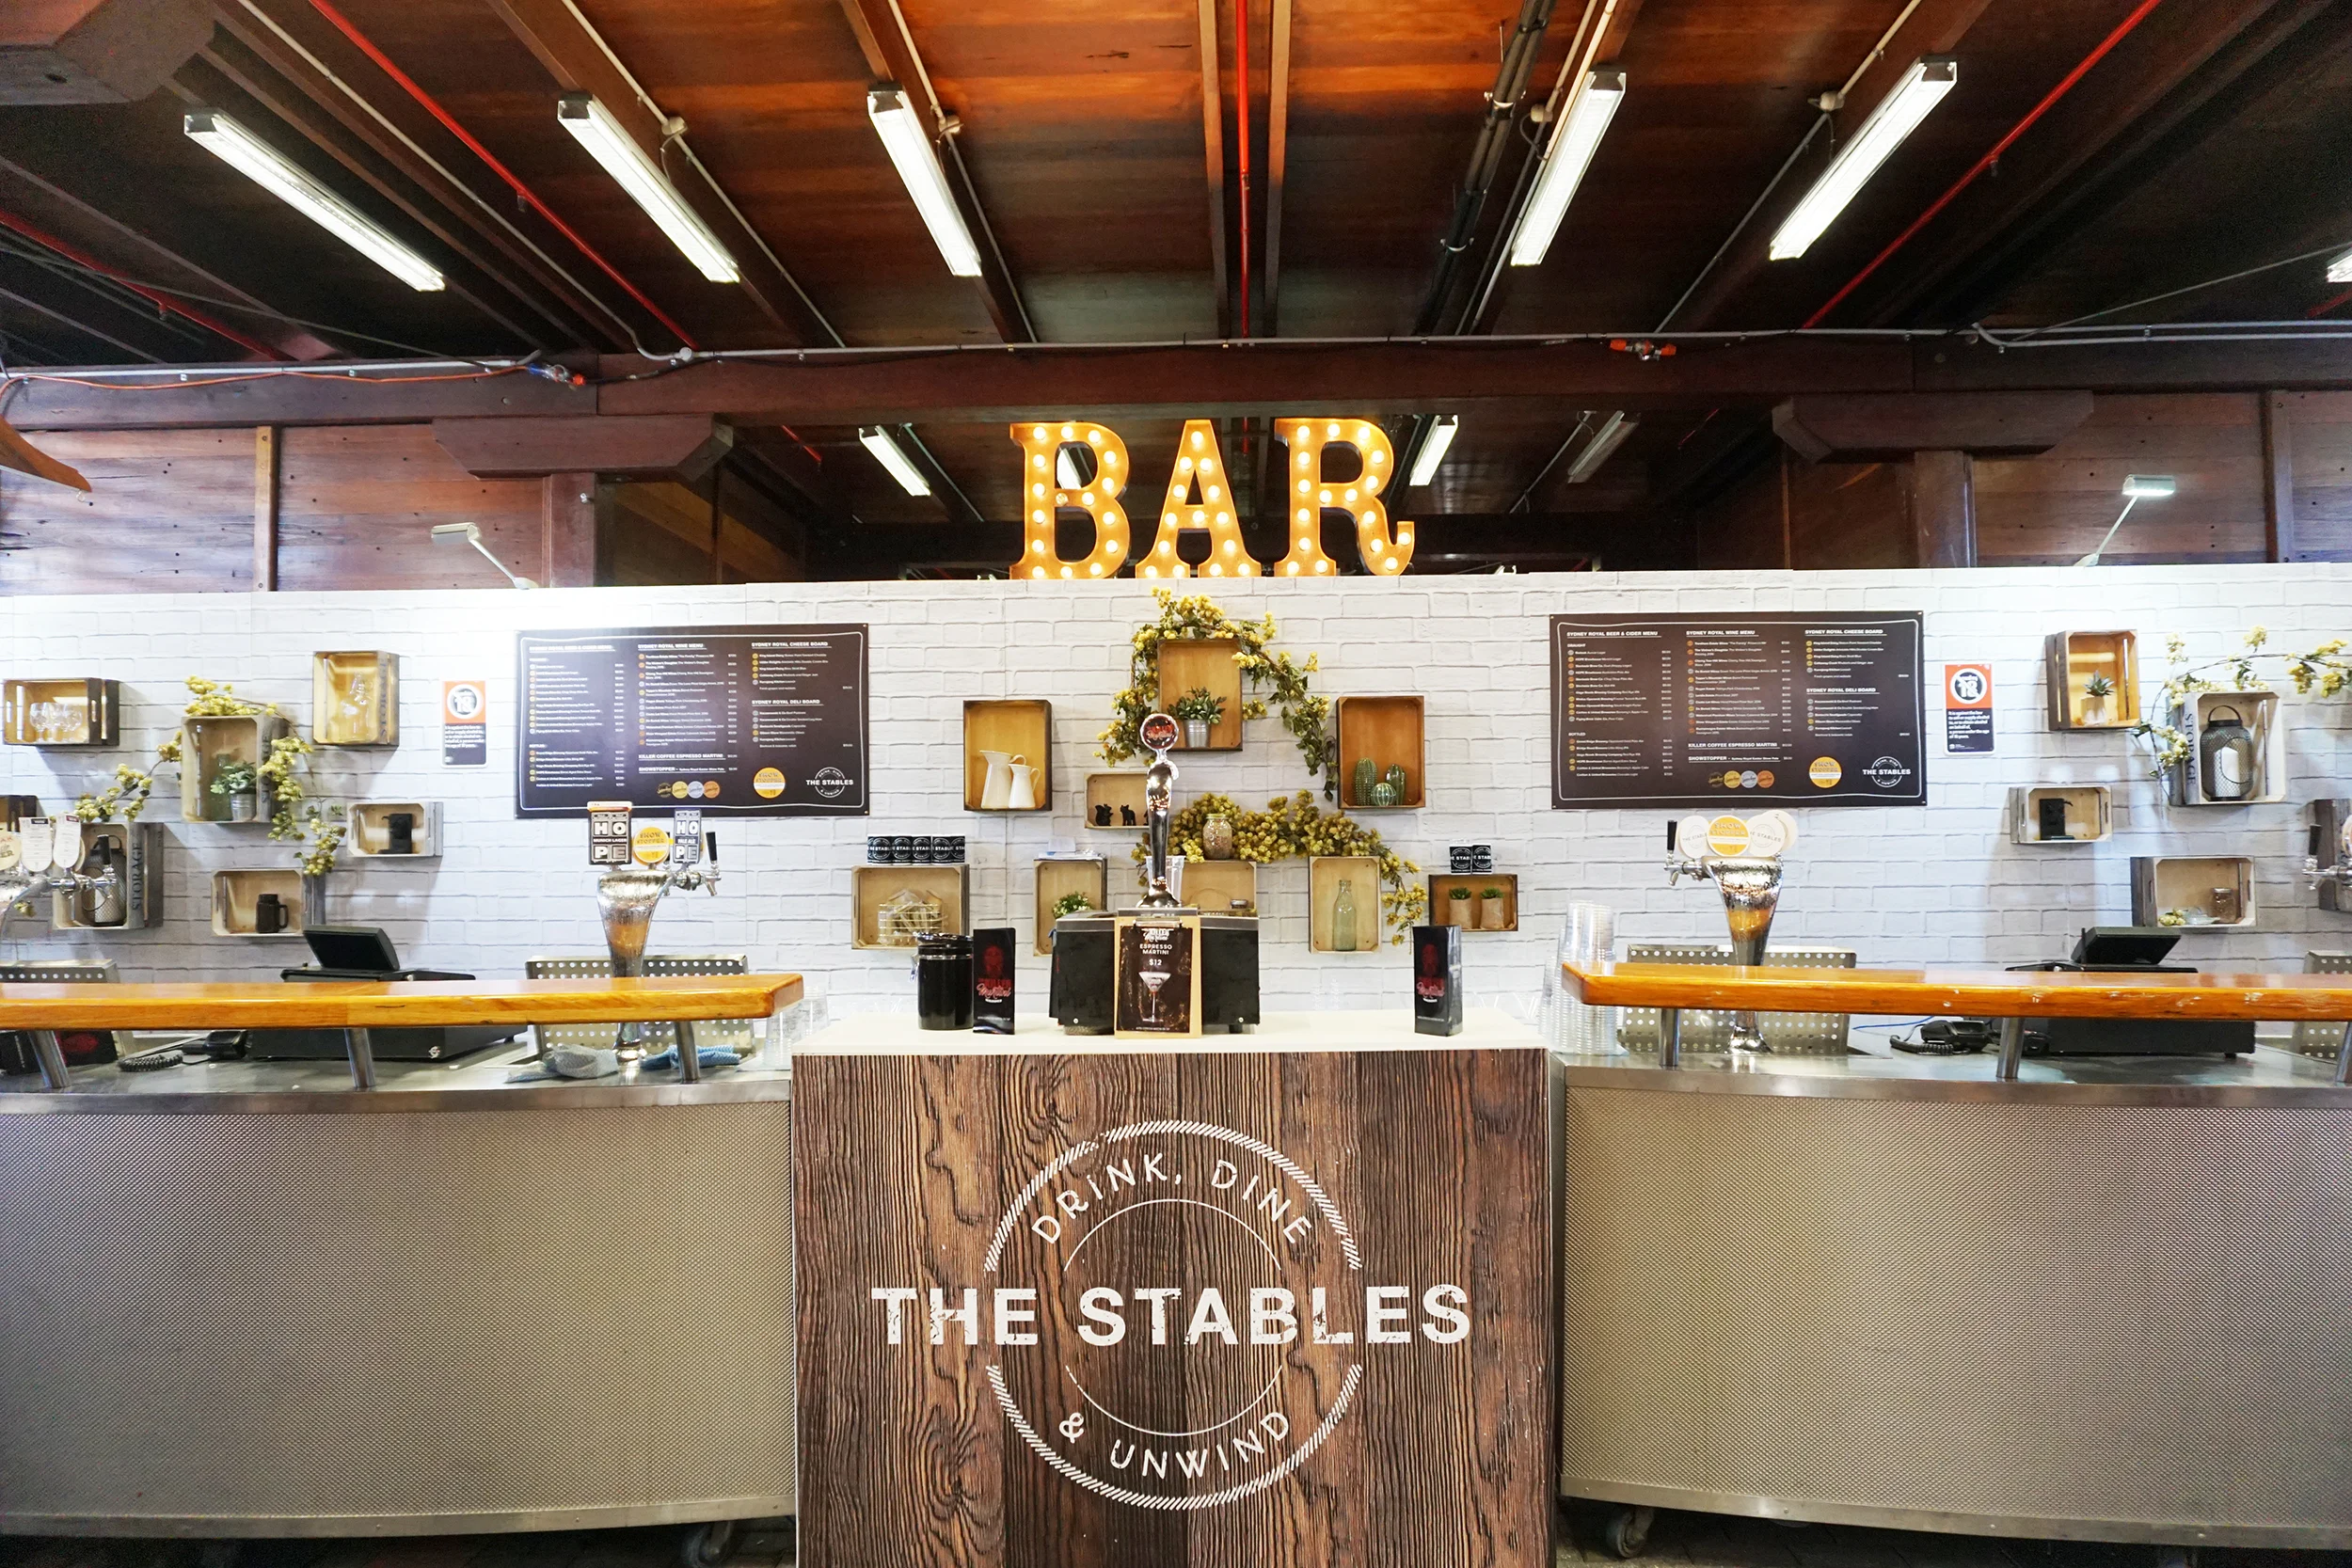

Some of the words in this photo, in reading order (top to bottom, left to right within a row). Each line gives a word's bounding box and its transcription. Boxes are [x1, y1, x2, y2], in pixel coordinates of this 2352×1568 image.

[1009, 418, 1415, 579] BAR
[133, 843, 142, 910] STORAGE
[1032, 1152, 1183, 1244] DRINK,
[1212, 1159, 1312, 1244] DINE
[871, 1288, 1038, 1346] THE
[1077, 1284, 1470, 1347] STABLES
[1058, 1412, 1086, 1444] &
[1109, 1411, 1290, 1480] UNWIND
